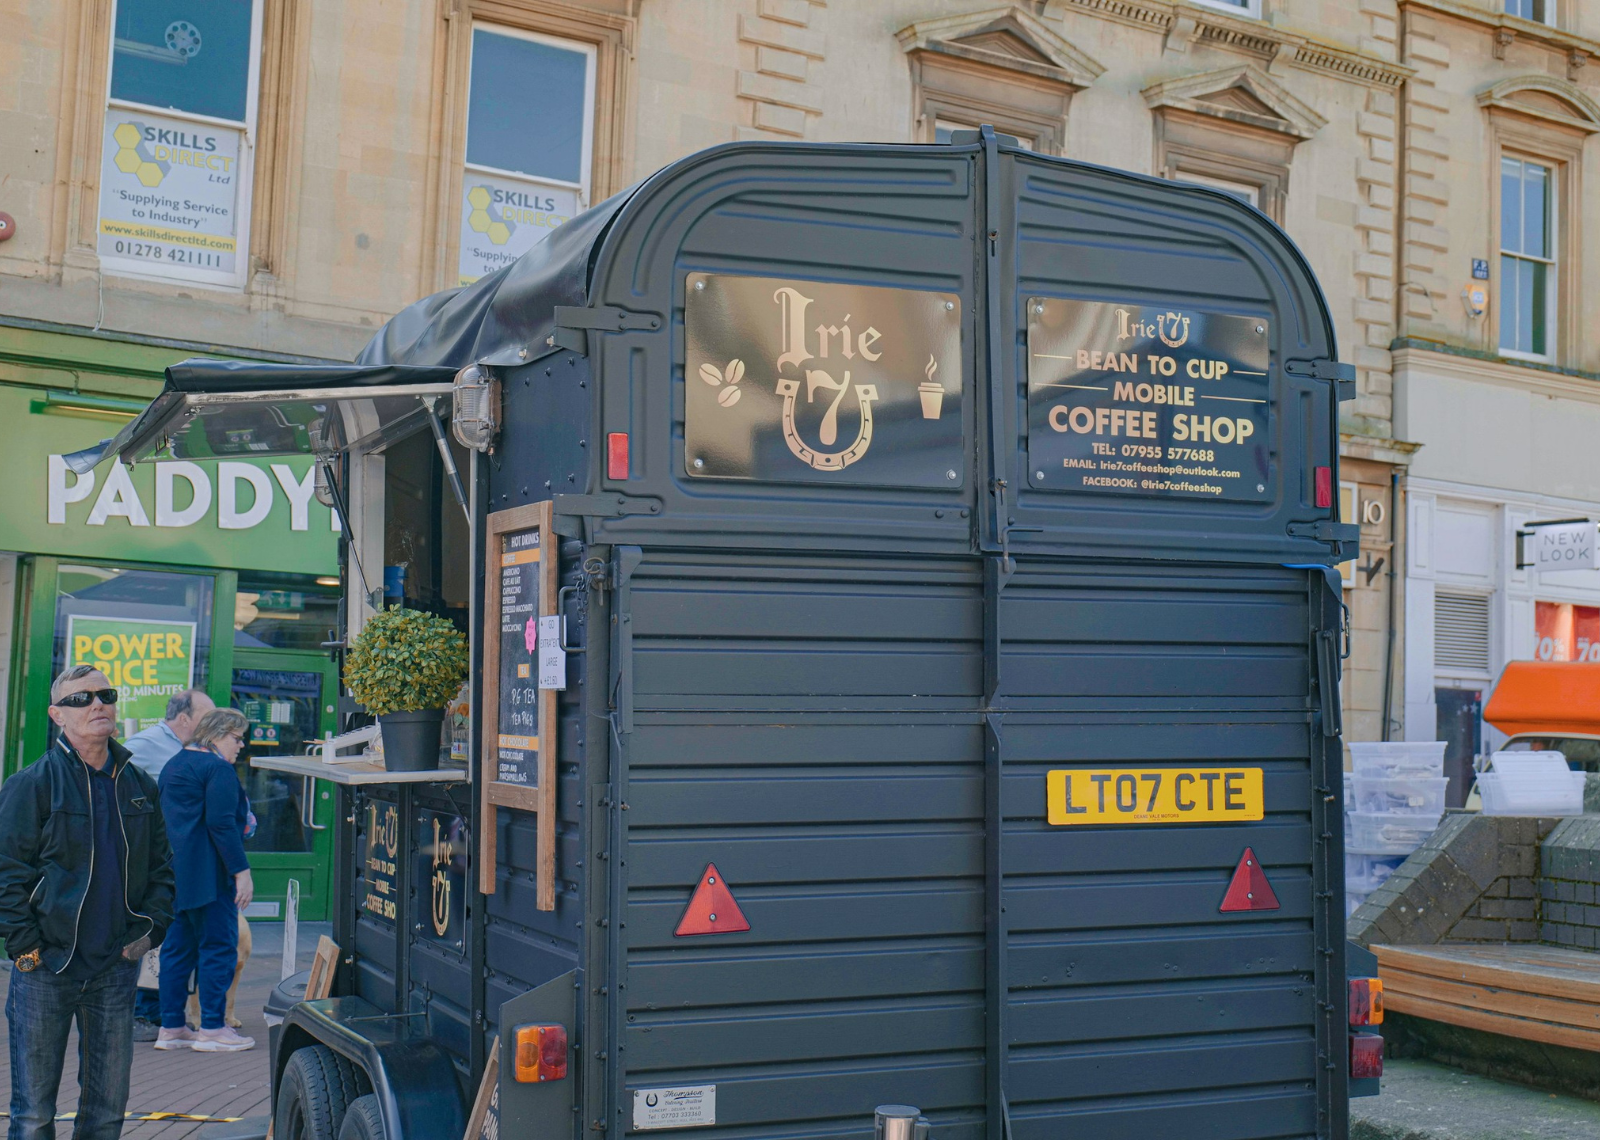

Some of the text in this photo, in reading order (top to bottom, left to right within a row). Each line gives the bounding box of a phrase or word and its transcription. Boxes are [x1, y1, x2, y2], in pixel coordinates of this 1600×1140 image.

[144, 126, 216, 152] SKILLS
[154, 145, 234, 172] DIRECT
[208, 174, 230, 184] Ltd
[132, 208, 145, 218] to
[184, 200, 228, 216] Service
[493, 190, 554, 212] SKILLS
[502, 206, 570, 228] DIRECT
[104, 224, 233, 250] www.skillsdirectltd.com
[116, 241, 220, 267] 01278 421111
[774, 287, 882, 373] Irie
[1115, 308, 1182, 342] Irie 7
[1076, 350, 1228, 380] BEAN TO CUP
[1113, 381, 1195, 406] MOBILE
[806, 370, 850, 445] 7
[1049, 405, 1254, 444] COFFEE SHOP
[1092, 442, 1214, 462] TEL: 07955 577688
[1064, 459, 1240, 478] EMAIL: Irie7coffeeshop@outlook.com
[48, 454, 342, 532] PADDY
[1083, 476, 1222, 494] FACEBOOK: @Irie7coffeeshop
[1363, 500, 1384, 524] 10
[511, 536, 521, 547] HOT
[522, 532, 539, 546] DRINKS
[1544, 532, 1586, 545] NEW
[1540, 548, 1589, 562] LOOK
[75, 633, 185, 661] POWER
[76, 660, 158, 686] RICE
[546, 657, 557, 666] LARGE
[134, 684, 184, 697] MINUTES
[523, 688, 535, 704] TEA
[512, 712, 521, 726] TEA
[1065, 772, 1246, 814] LT07 CTE
[371, 804, 385, 849] Irie
[433, 818, 452, 871] Irie
[382, 861, 386, 873] TO
[387, 862, 396, 876] CUP
[376, 879, 389, 895] MOBILE
[366, 894, 396, 920] COFFEE SHO
